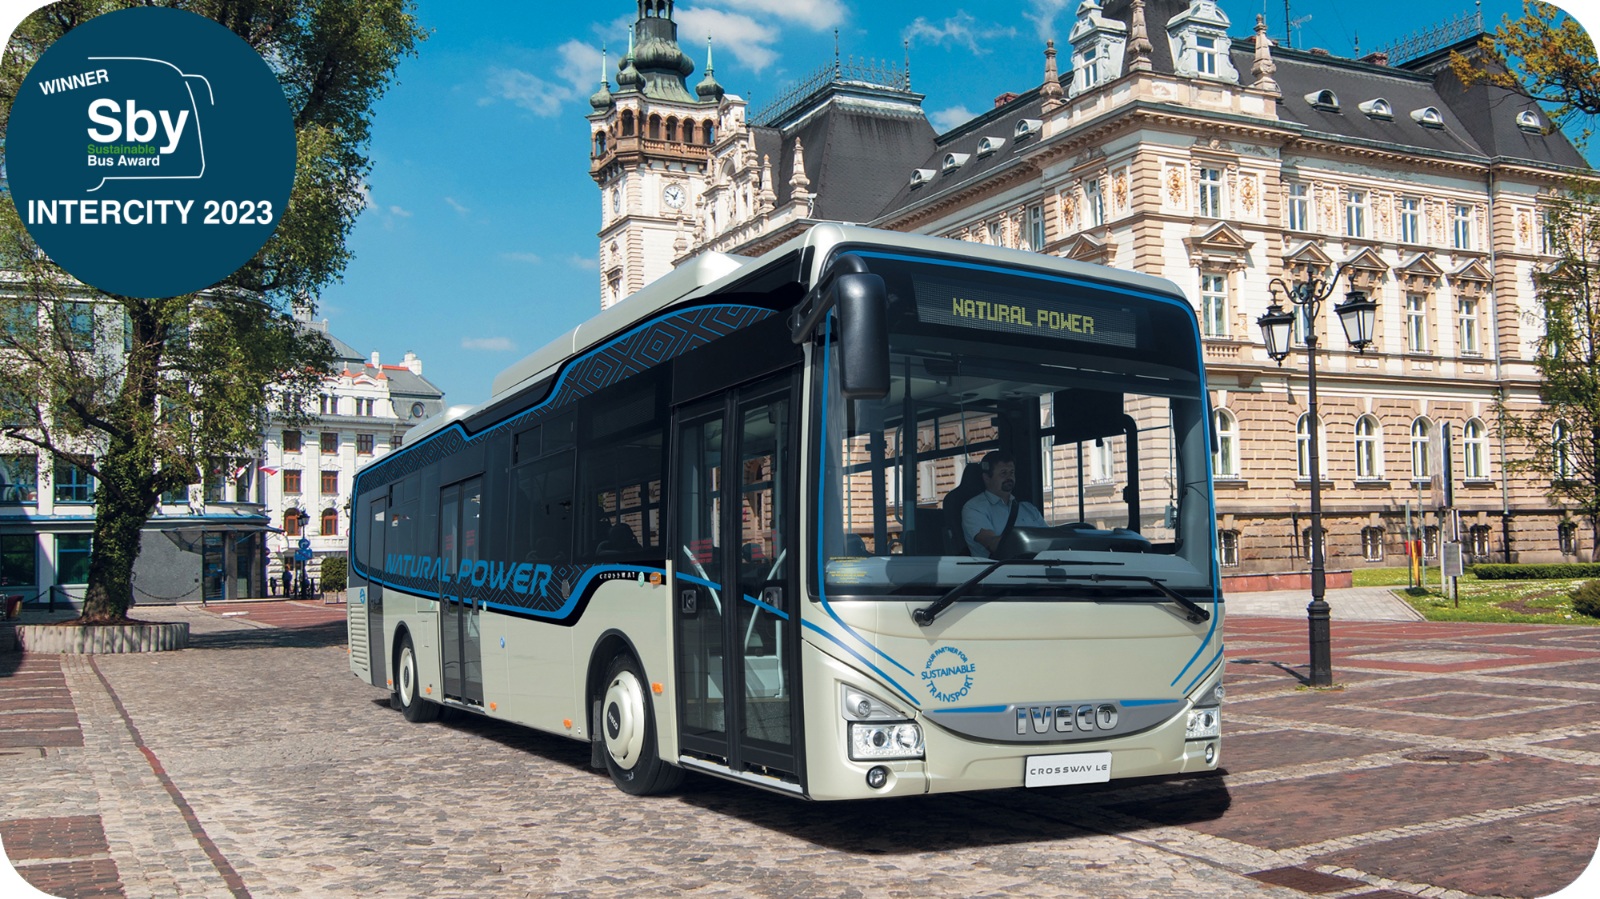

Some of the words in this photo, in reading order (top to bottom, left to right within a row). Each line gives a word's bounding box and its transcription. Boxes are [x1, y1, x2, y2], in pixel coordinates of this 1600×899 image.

[952, 297, 1033, 327] NATURAL
[1037, 309, 1095, 335] POWER
[385, 553, 451, 583] NATURAL
[457, 558, 552, 597] POWER
[957, 650, 968, 663] FOR
[921, 663, 976, 680] SUSTAINABLE
[926, 674, 974, 702] TRANSPORT
[1015, 703, 1118, 735] IVECO
[1030, 765, 1092, 776] CROSSWAY
[1095, 764, 1108, 772] LE
